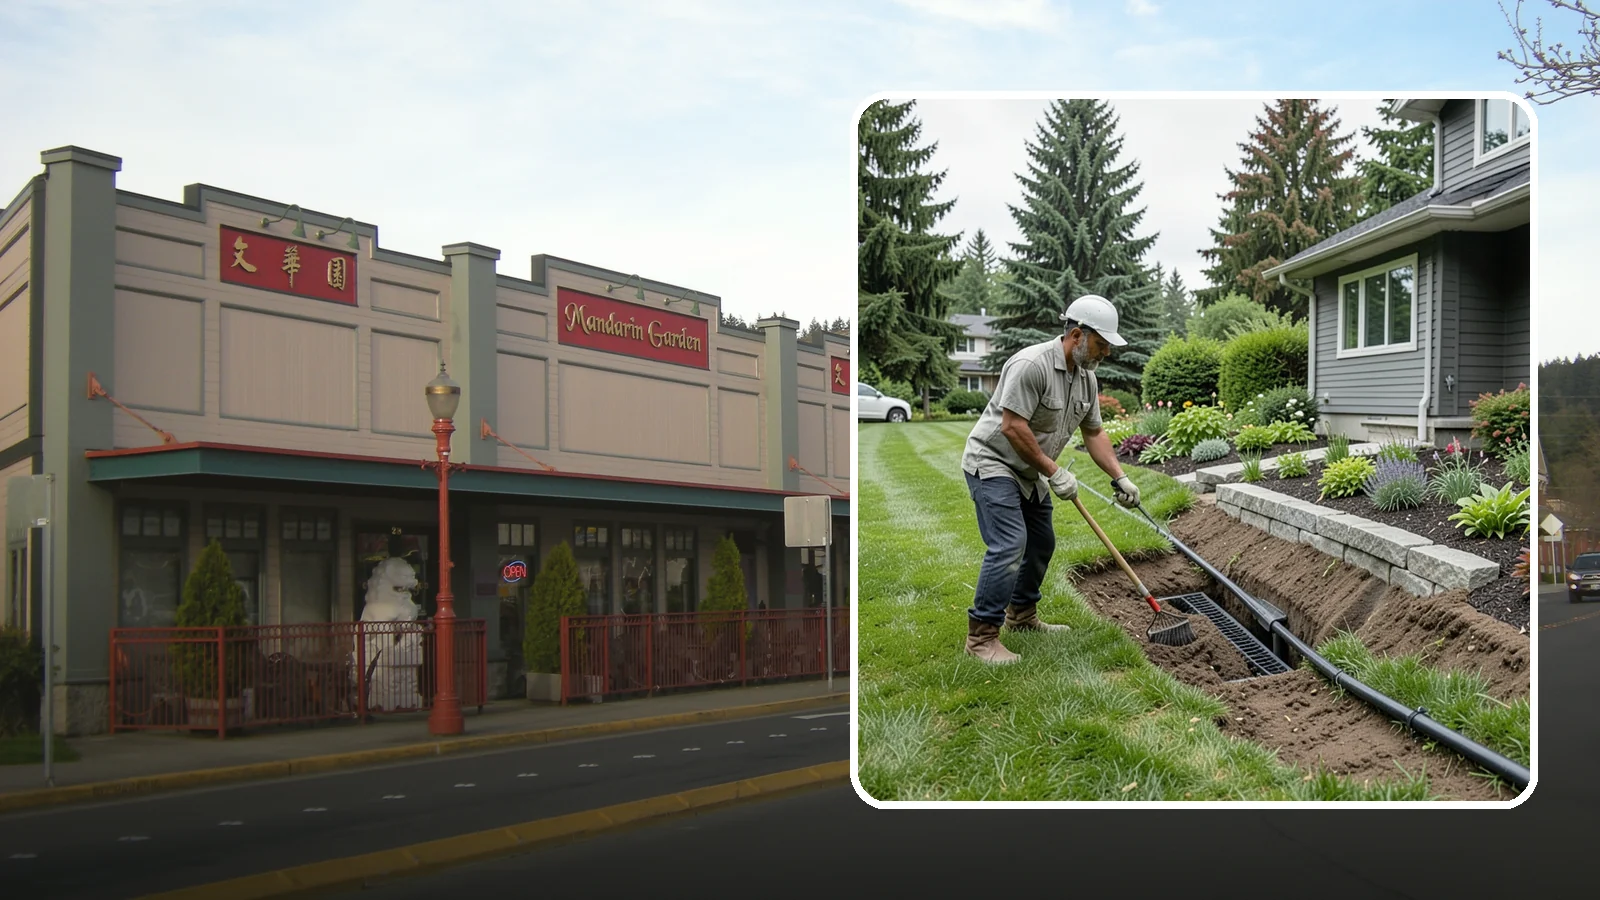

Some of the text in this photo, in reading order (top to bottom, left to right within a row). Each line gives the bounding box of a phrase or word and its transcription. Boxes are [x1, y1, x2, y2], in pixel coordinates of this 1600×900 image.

[231, 235, 346, 291] 文華園
[564, 302, 701, 352] Mandarin Garden
[503, 565, 527, 578] OPEN
